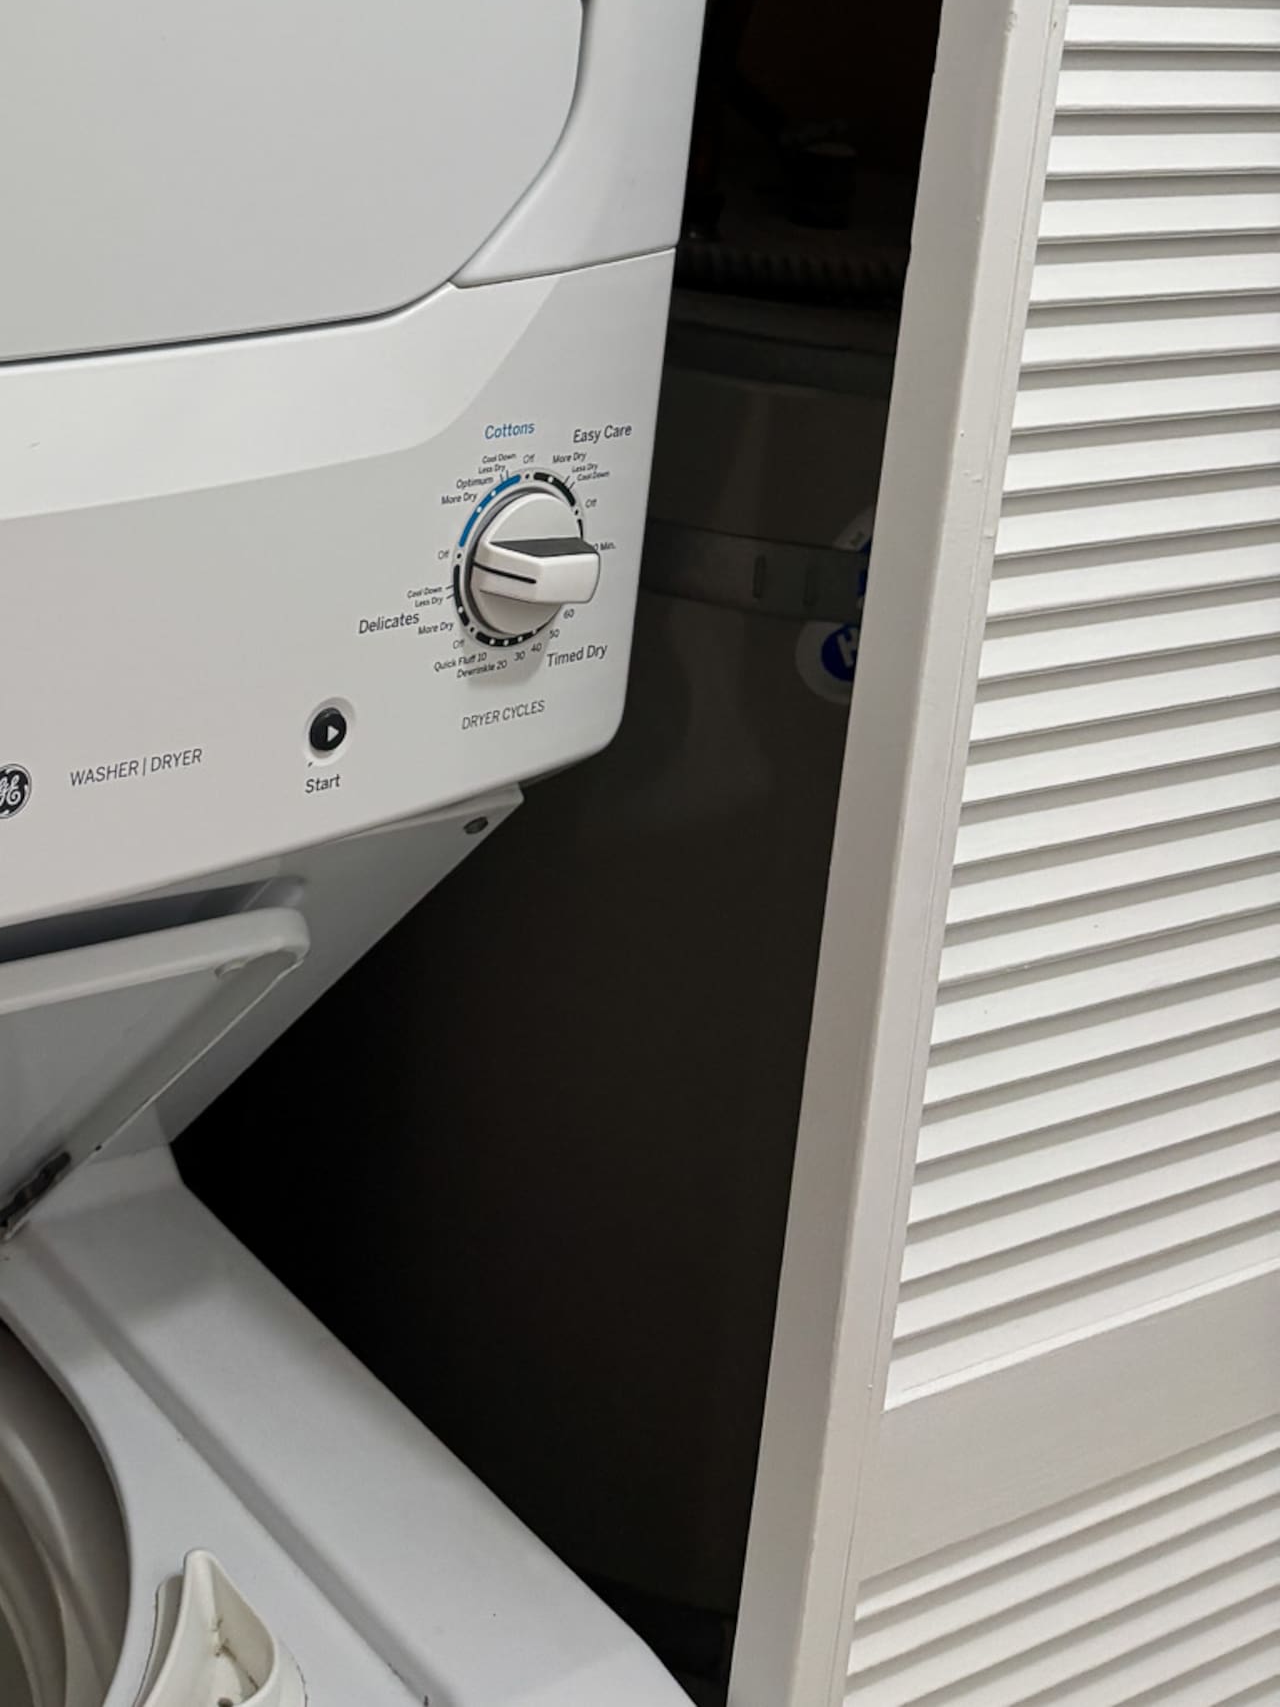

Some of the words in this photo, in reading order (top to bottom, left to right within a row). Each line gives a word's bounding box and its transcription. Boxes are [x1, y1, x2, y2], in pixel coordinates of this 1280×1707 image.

[484, 422, 535, 440] Cottons
[572, 426, 602, 444] Easy
[604, 423, 632, 440] Care
[523, 453, 535, 464] Off
[552, 454, 571, 464] More
[573, 452, 587, 462] Dry
[495, 463, 506, 473] Dry
[587, 462, 598, 471] Dry
[456, 476, 494, 490] Optimum
[441, 494, 461, 505] More
[463, 492, 477, 502] Dry
[585, 498, 597, 508] Off
[438, 549, 449, 560] Off
[431, 597, 443, 606] Dry
[563, 608, 575, 619] 60
[358, 612, 420, 635] Delicates
[418, 625, 438, 635] More
[440, 622, 454, 631] Dry
[549, 629, 560, 639] 50
[452, 639, 465, 649] Off
[530, 643, 543, 653] 40
[514, 651, 526, 662] 30
[547, 648, 584, 667] Timed
[585, 644, 608, 664] Dry
[433, 659, 457, 672] Quick
[458, 654, 477, 666] Fluff
[478, 652, 487, 662] 10
[497, 660, 508, 670] 20
[462, 709, 500, 730] DRYER
[503, 700, 545, 722] CYCLES
[70, 760, 139, 787] WASHER
[150, 748, 202, 773] DRYER
[305, 774, 341, 794] Start
